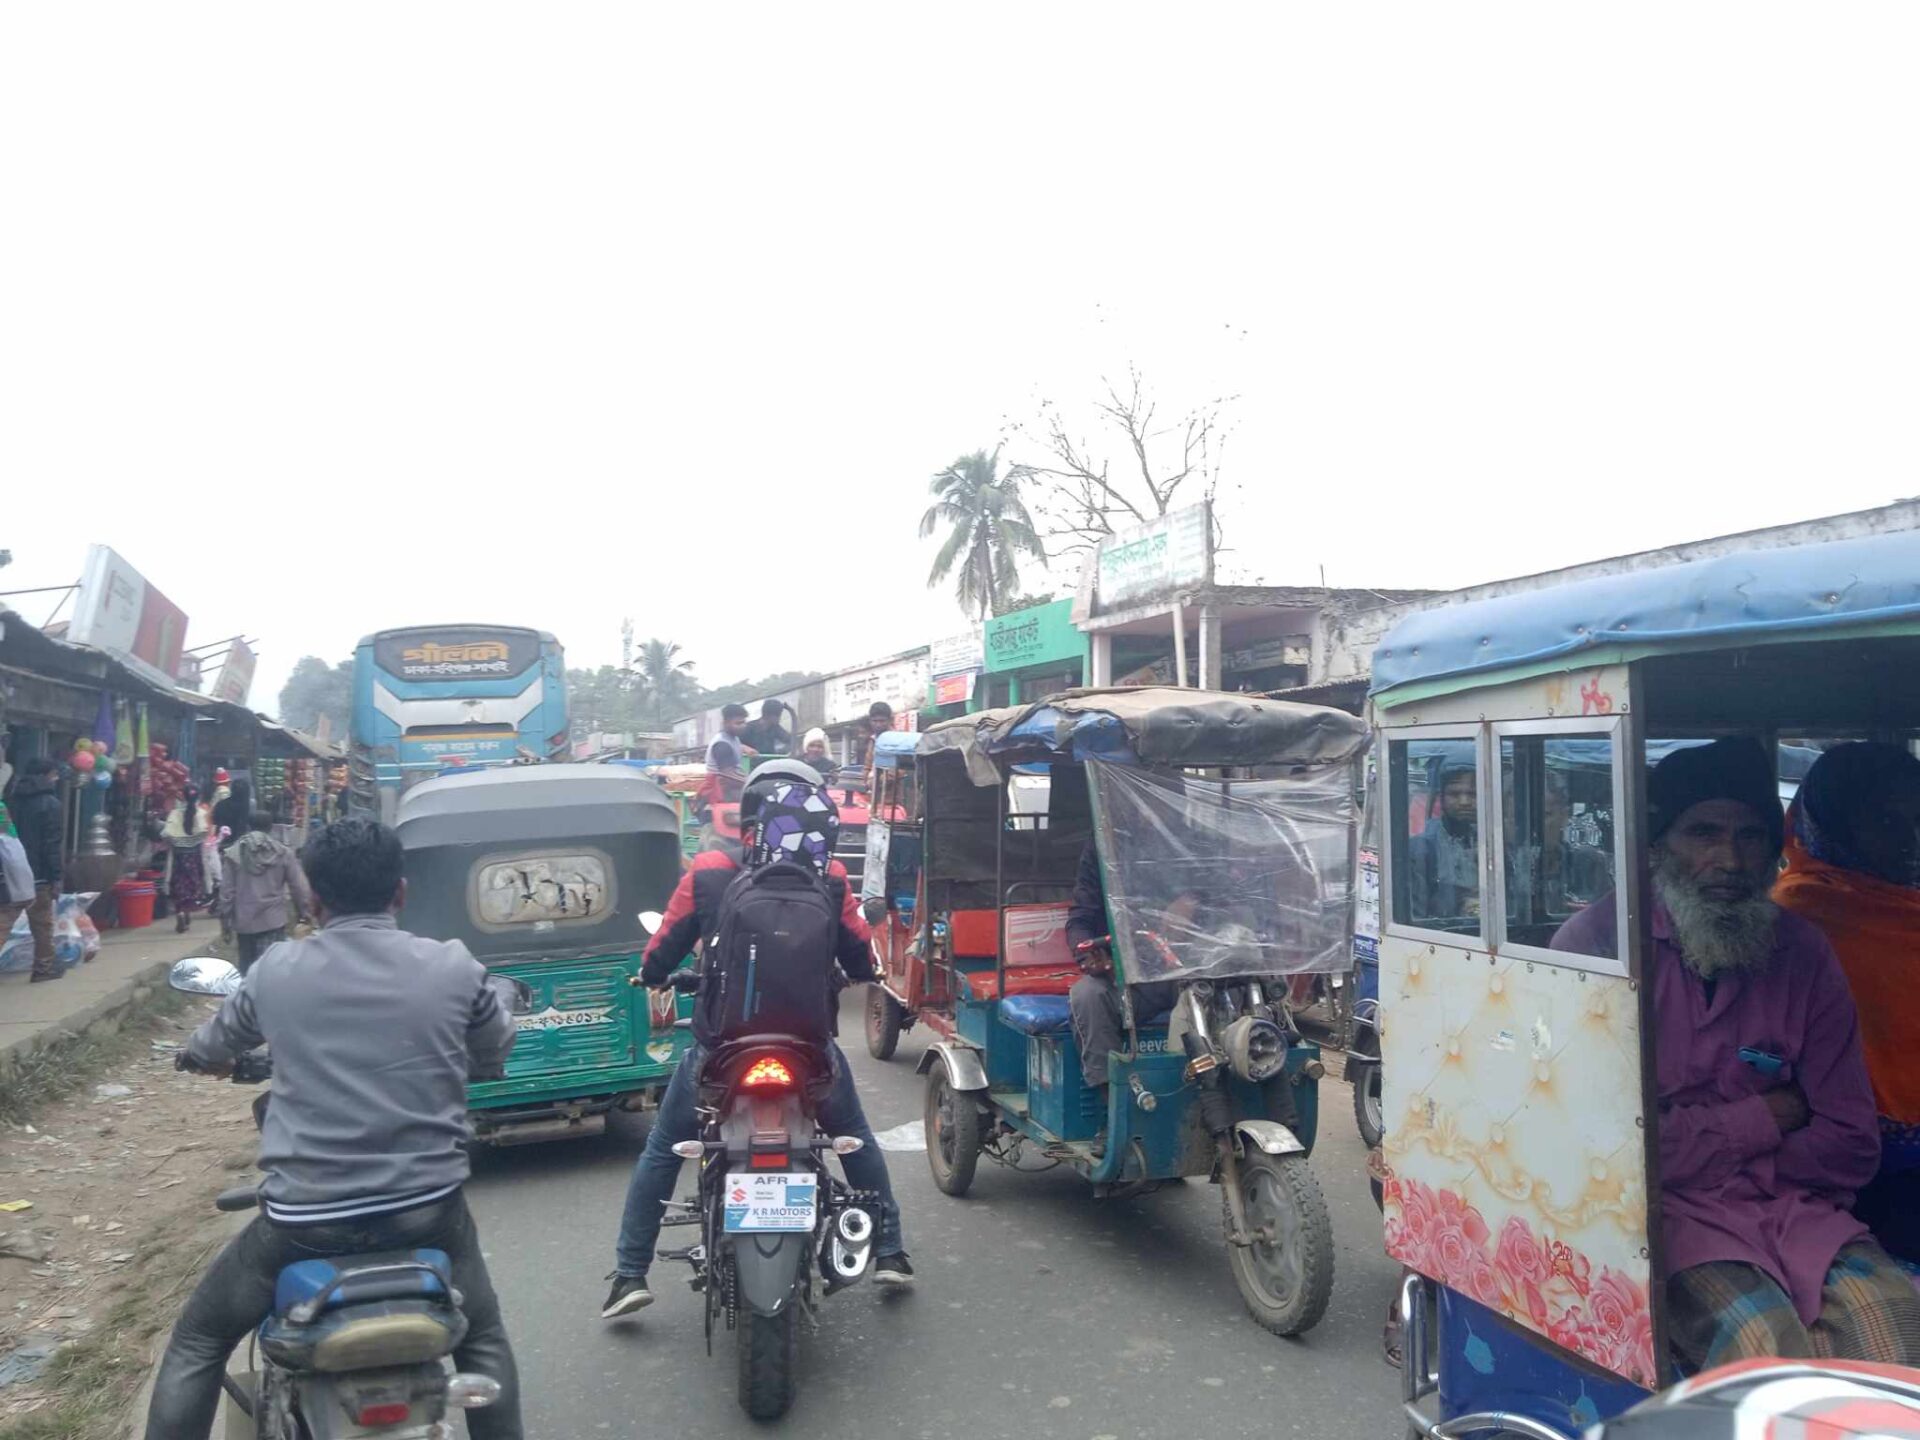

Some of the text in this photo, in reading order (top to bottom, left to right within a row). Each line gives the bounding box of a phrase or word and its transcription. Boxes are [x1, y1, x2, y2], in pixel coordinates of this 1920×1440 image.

[754, 1176, 788, 1185] AFR
[752, 1207, 760, 1216] K
[761, 1207, 768, 1216] R
[770, 1207, 812, 1216] MOTORS
